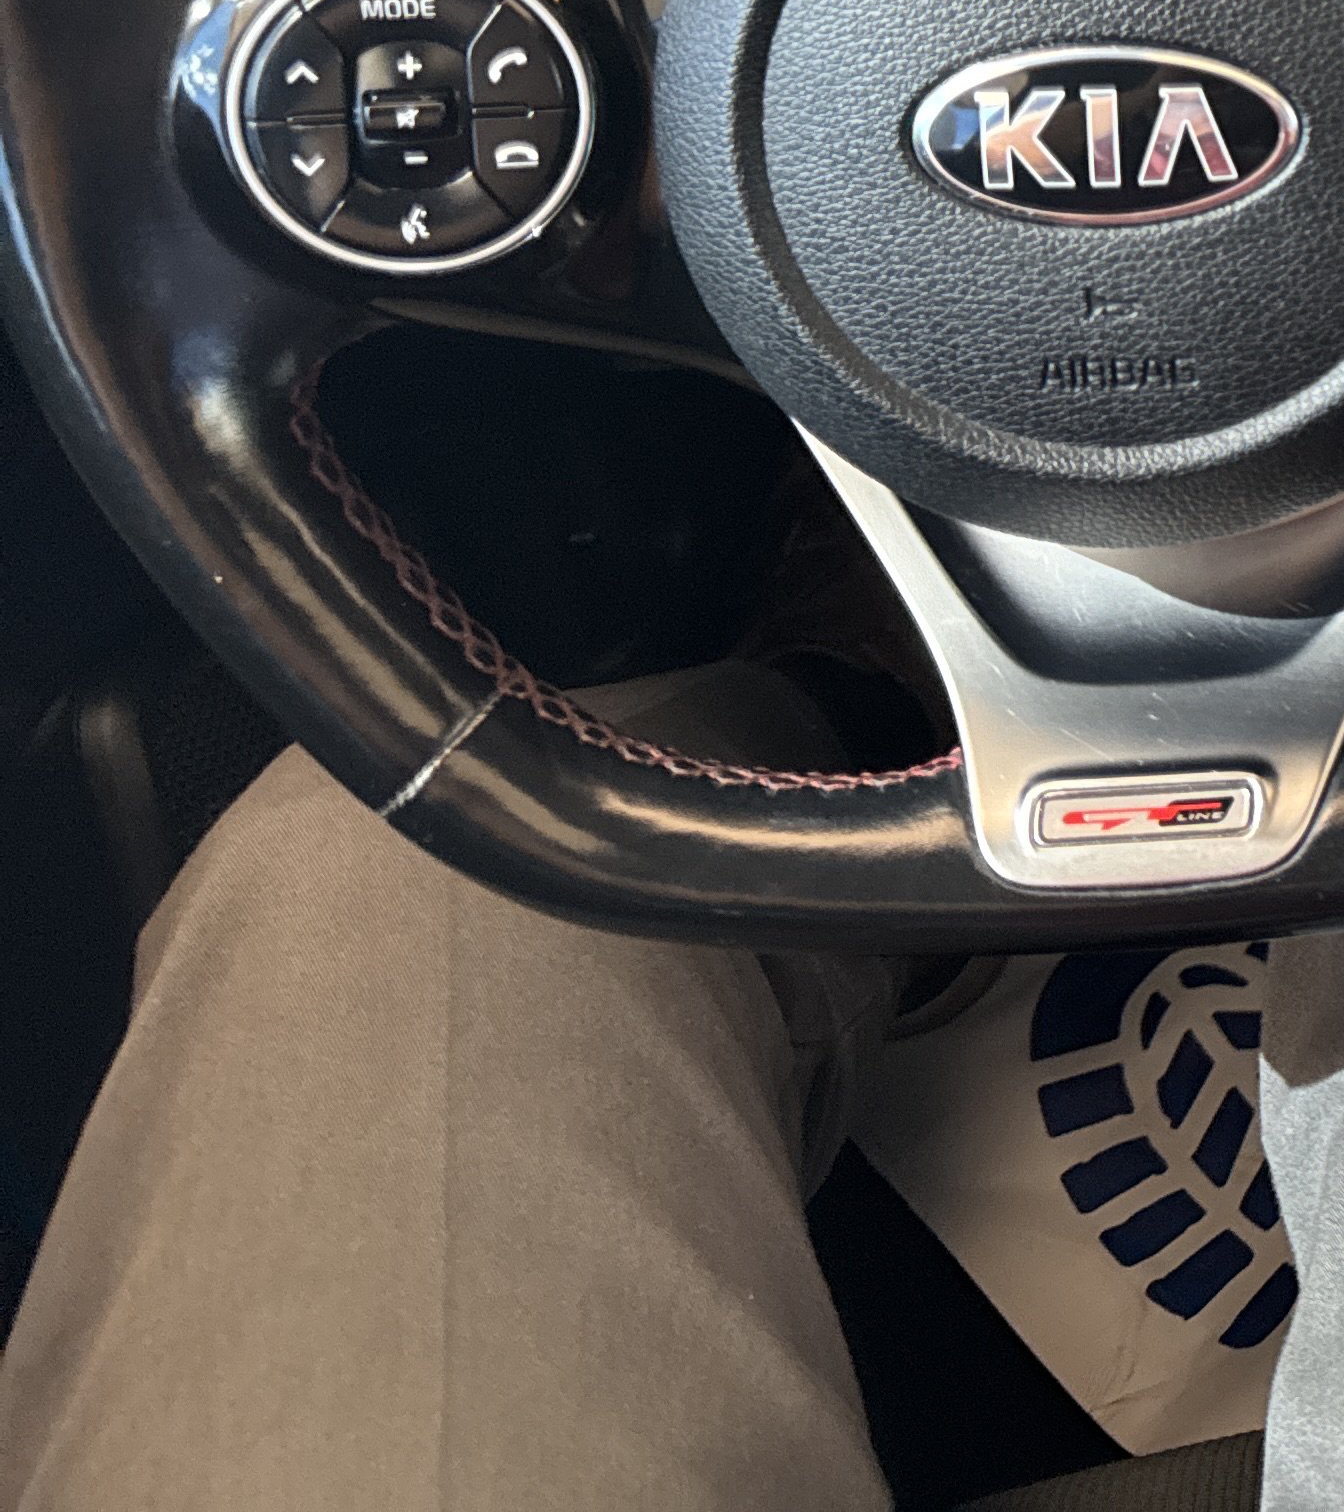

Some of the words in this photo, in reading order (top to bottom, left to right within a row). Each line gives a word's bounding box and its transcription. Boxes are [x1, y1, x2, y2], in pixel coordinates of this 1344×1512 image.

[974, 83, 1239, 189] KIA
[1040, 356, 1200, 391] AIRBAG
[1176, 811, 1226, 823] LINE
